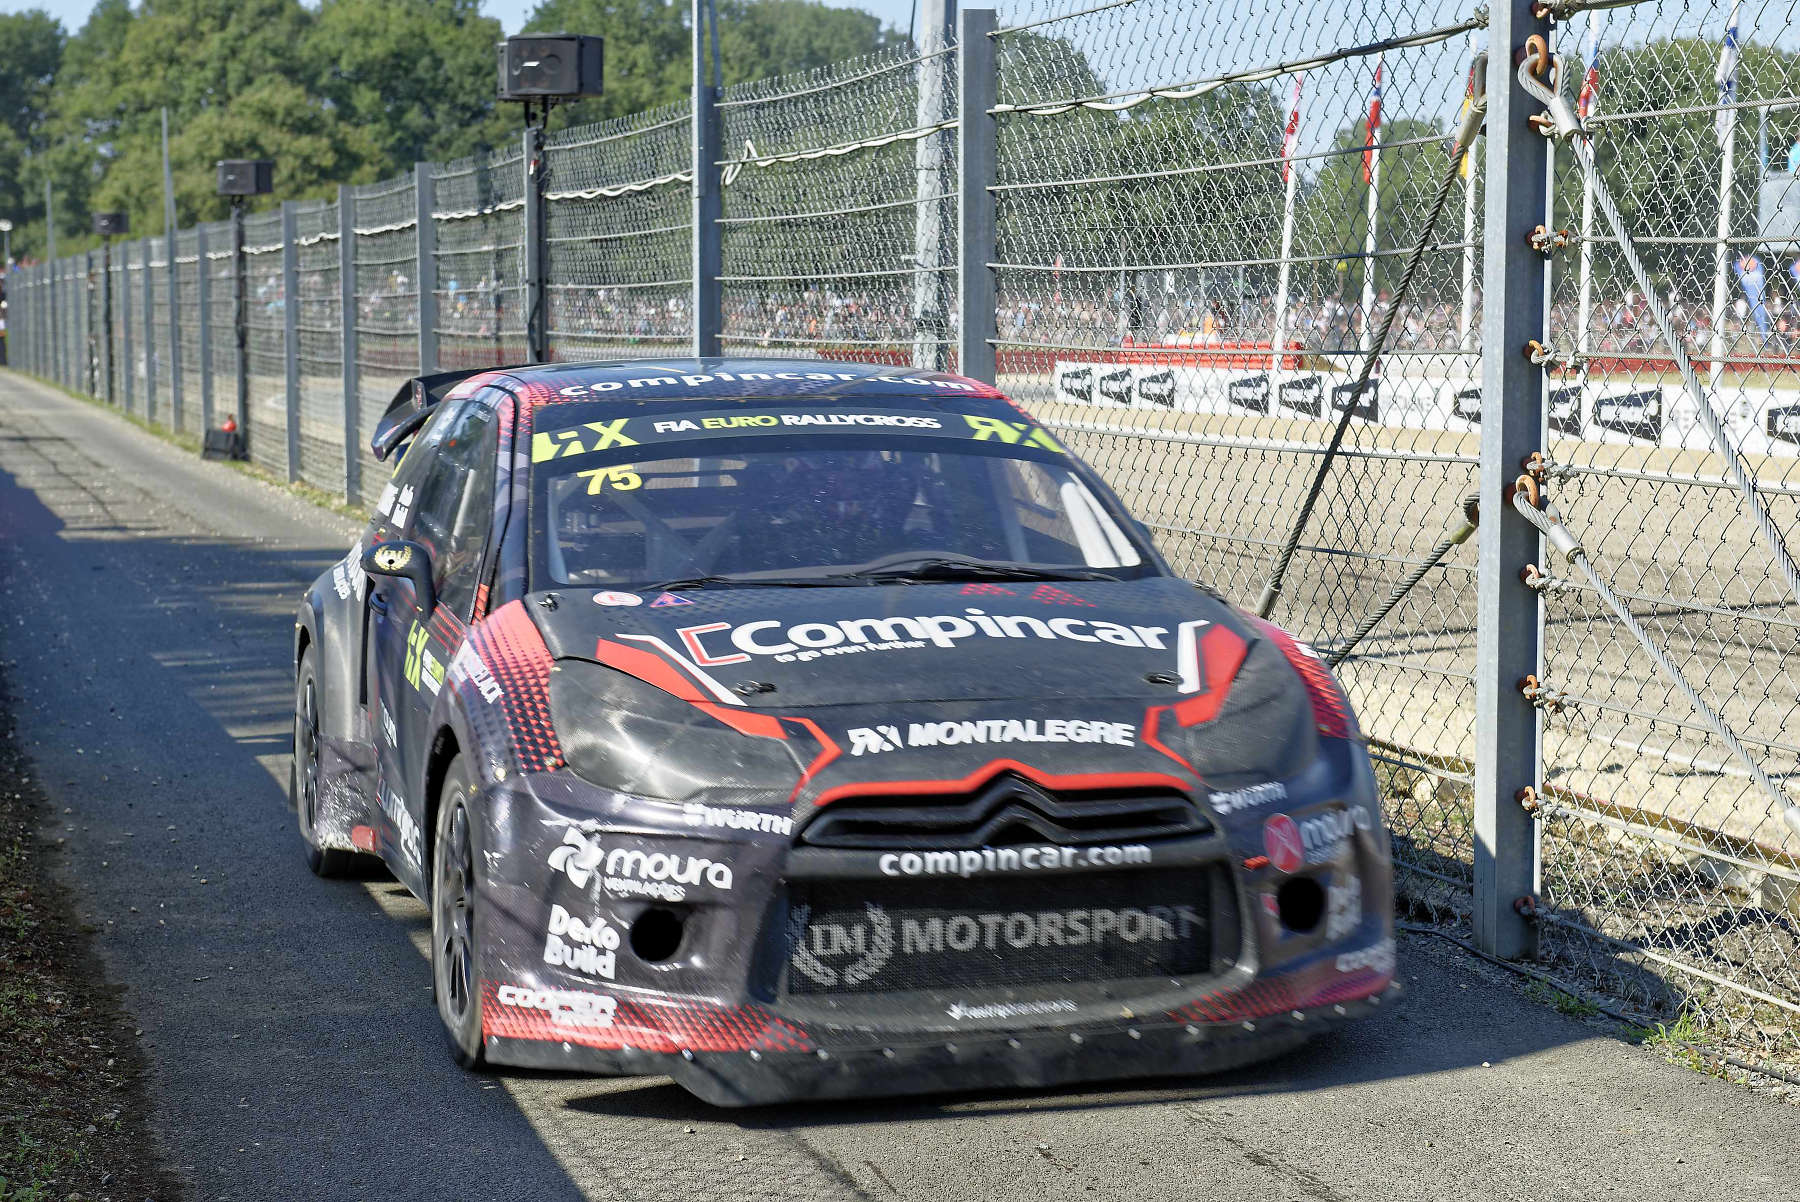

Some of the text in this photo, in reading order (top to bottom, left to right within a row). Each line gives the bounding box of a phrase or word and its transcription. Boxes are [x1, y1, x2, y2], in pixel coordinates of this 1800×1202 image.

[559, 371, 975, 396] compincar.com
[652, 414, 943, 433] FIA EURO RALLYCROSS
[576, 464, 643, 496] 75
[731, 608, 1169, 655] Compincar
[866, 639, 927, 651] further
[908, 719, 1135, 747] MONTALEGRE
[605, 848, 733, 890] moura
[879, 844, 1152, 878] compincar.com
[901, 904, 1195, 954] MOTORSPORT
